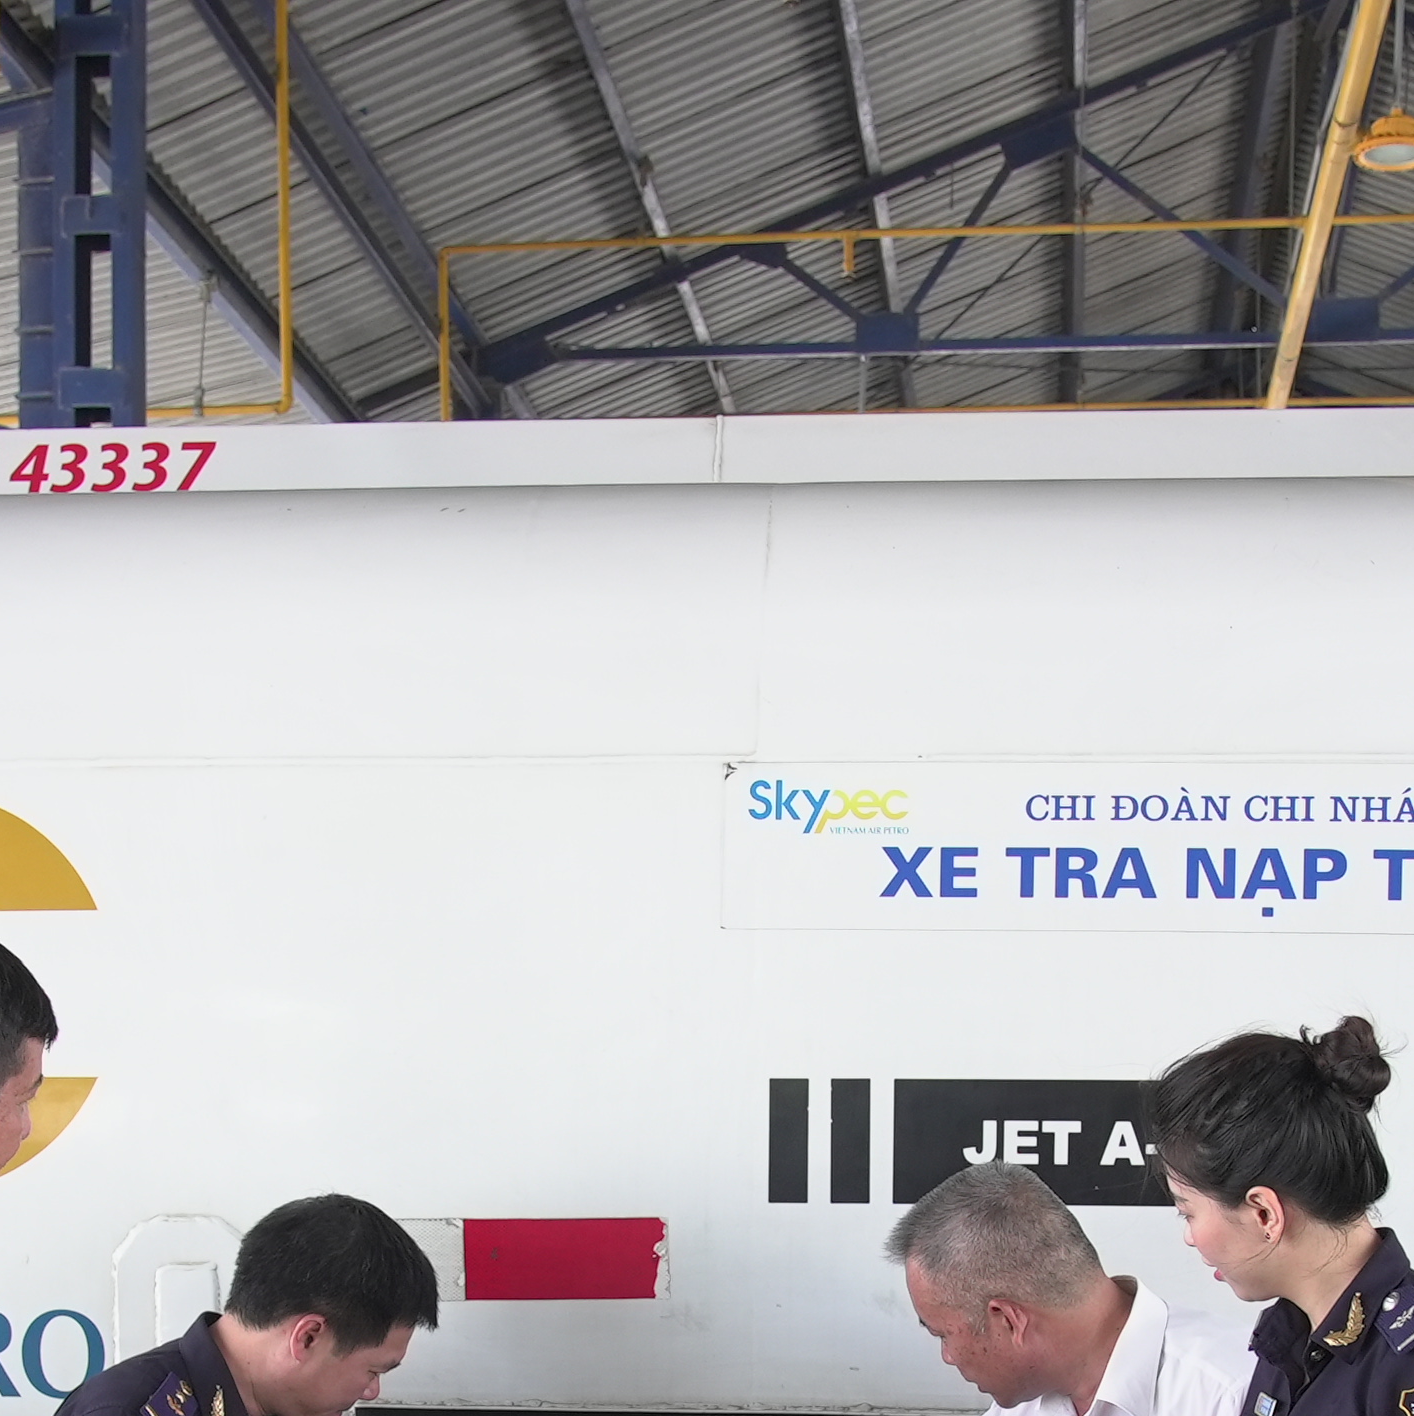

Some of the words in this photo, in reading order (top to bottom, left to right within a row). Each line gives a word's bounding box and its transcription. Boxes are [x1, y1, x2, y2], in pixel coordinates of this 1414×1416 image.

[10, 441, 218, 495] 43337
[748, 779, 909, 834] Skypec
[1026, 795, 1096, 822] CHI
[1112, 788, 1232, 823] ĐOÀN
[1244, 796, 1316, 824] CHI
[880, 847, 980, 899] XE
[1006, 848, 1158, 900] TRA
[1186, 848, 1350, 918] NẠP
[962, 1119, 1083, 1167] JET
[1099, 1120, 1160, 1167] A-
